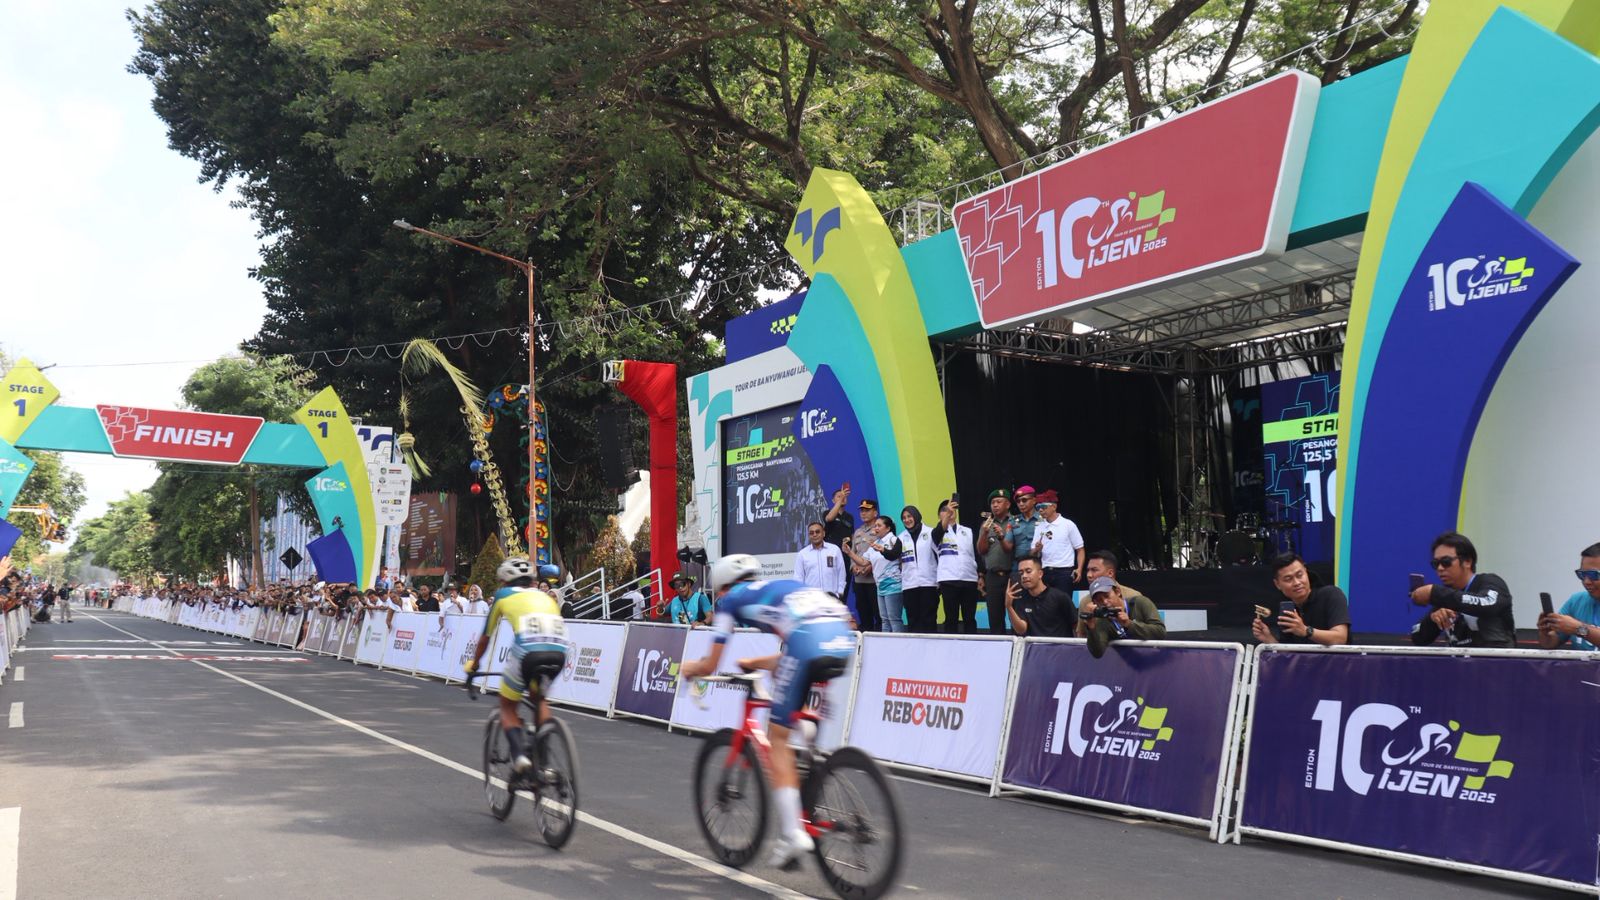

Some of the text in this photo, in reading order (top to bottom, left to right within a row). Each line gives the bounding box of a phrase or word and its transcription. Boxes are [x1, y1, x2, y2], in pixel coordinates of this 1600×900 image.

[1088, 234, 1168, 269] IJEN 2025
[1467, 282, 1528, 300] IJEN 2025
[734, 381, 749, 392] TOUR
[750, 379, 756, 388] DE
[757, 367, 797, 386] BANYUWANGI
[9, 384, 44, 394] STAGE
[13, 398, 26, 416] 1
[308, 409, 337, 418] STAGE
[134, 424, 234, 448] FINISH
[317, 422, 328, 438] 1
[736, 448, 760, 460] STAGE
[1302, 450, 1332, 462] 125,5
[750, 470, 758, 479] KM
[755, 508, 774, 520] IJEN
[649, 680, 668, 692] IJEN
[892, 682, 962, 700] BANYUWANGI
[882, 700, 964, 730] REBOUND
[1409, 706, 1422, 714] TH
[1044, 721, 1054, 752] EDITION
[1090, 735, 1161, 761] IJEN 2025
[1304, 748, 1316, 788] EDITION
[1443, 764, 1480, 773] BANYUWANGI
[1378, 768, 1497, 804] IJEN 2025
